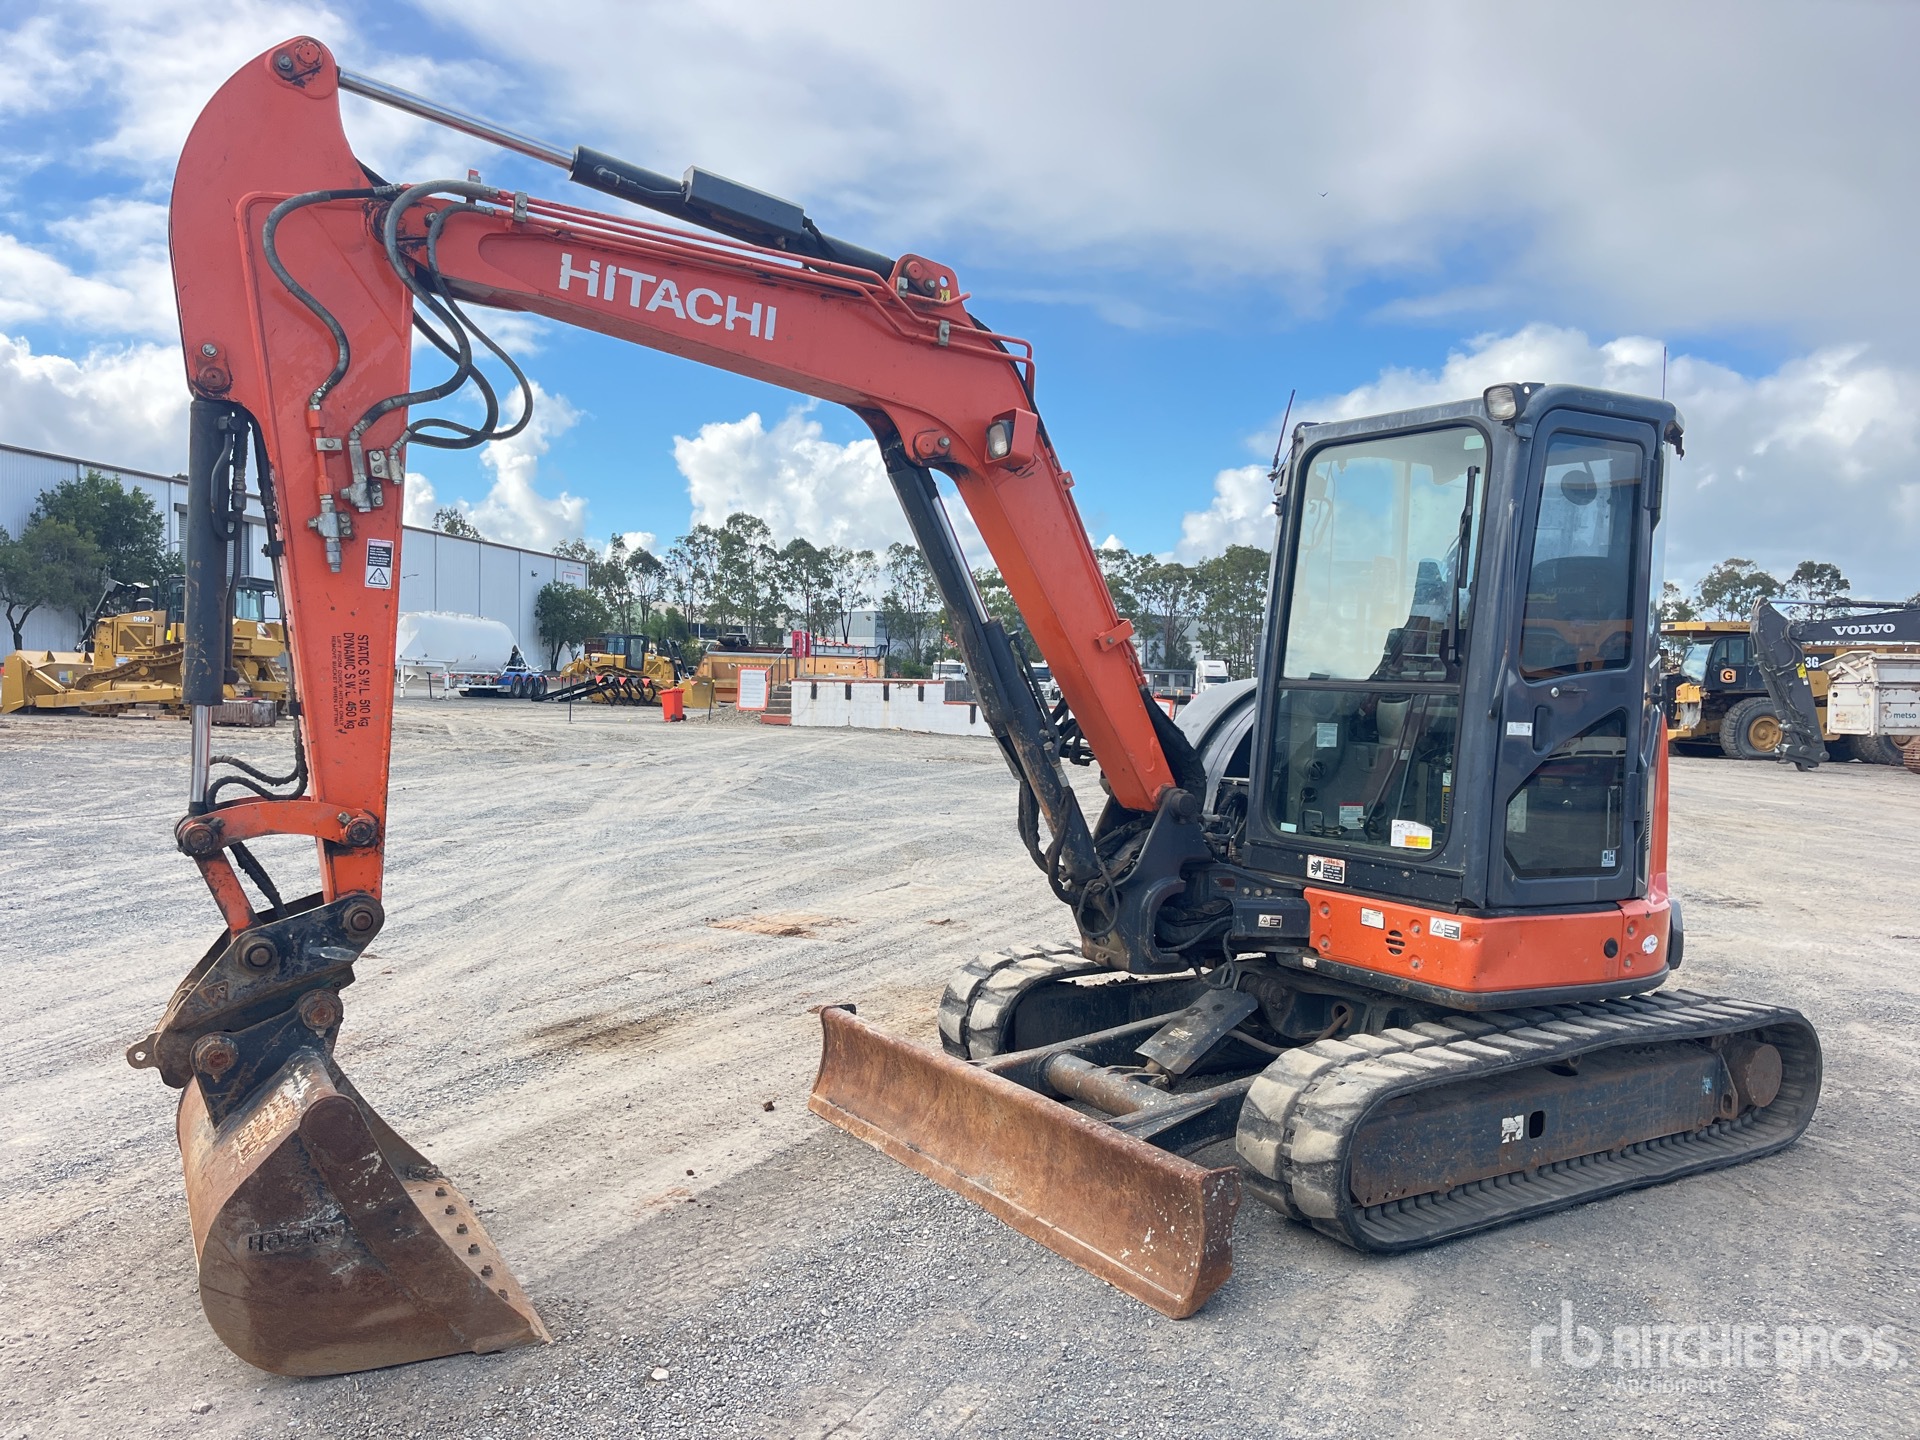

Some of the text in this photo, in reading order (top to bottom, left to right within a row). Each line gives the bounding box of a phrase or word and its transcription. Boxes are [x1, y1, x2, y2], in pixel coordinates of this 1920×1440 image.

[558, 252, 777, 341] HITACHI
[1832, 623, 1896, 636] VOLVO
[343, 632, 356, 671] DYNAMIC
[357, 634, 370, 666] STATIC
[1722, 670, 1733, 681] G
[345, 700, 357, 717] 450
[359, 699, 371, 714] 510
[343, 719, 356, 729] kg
[358, 716, 371, 727] kg
